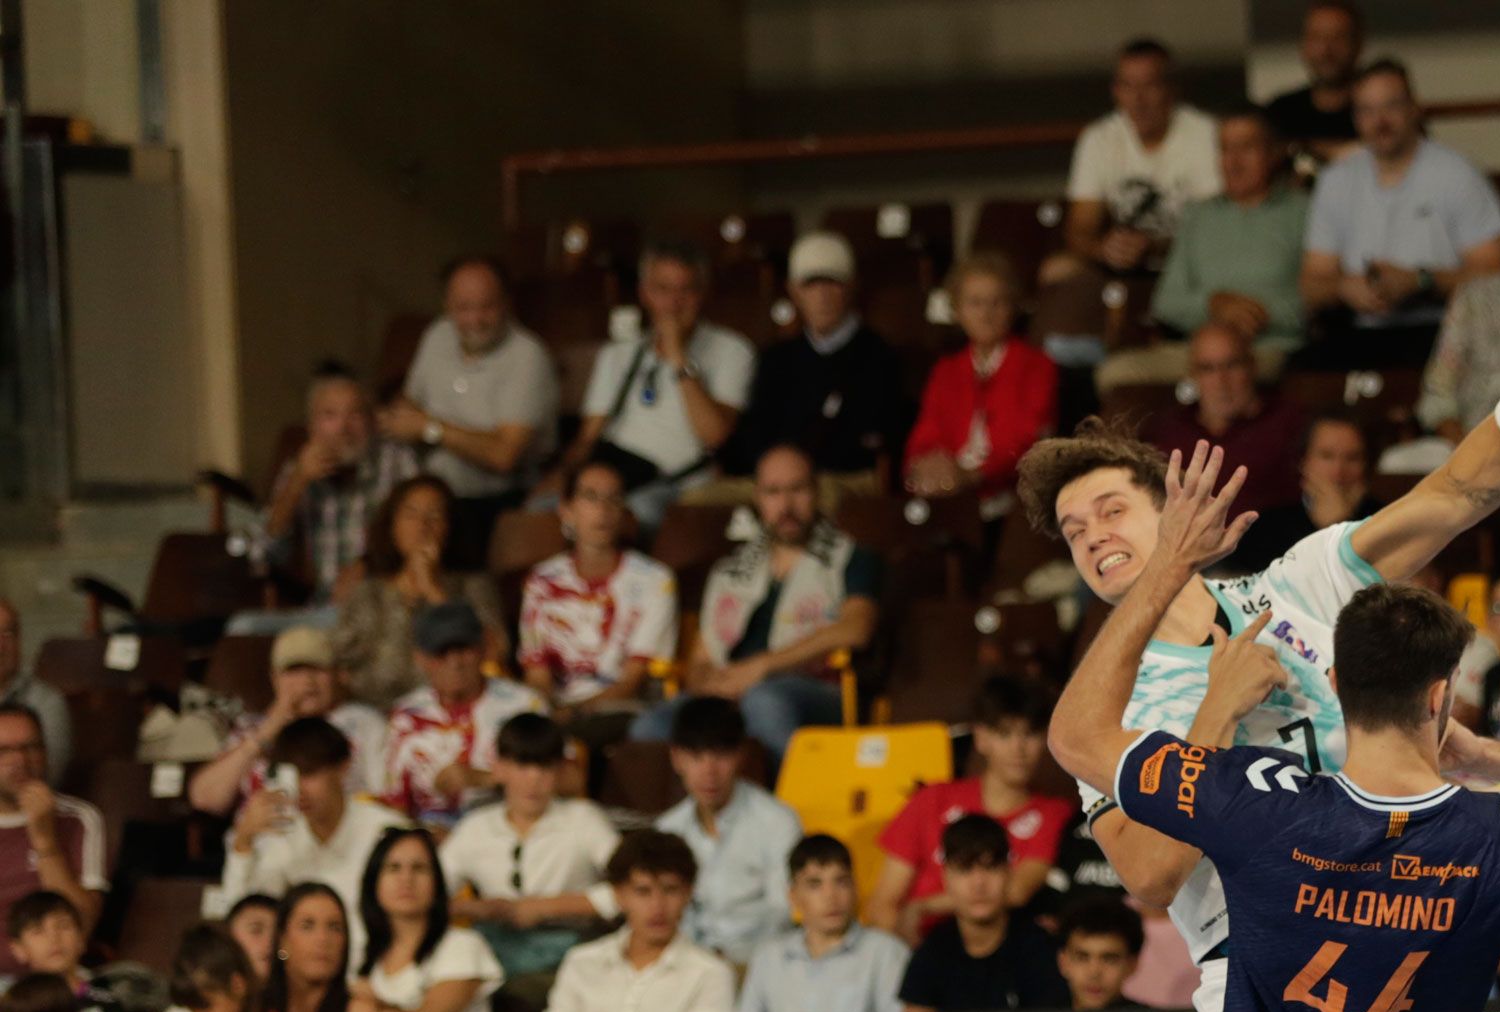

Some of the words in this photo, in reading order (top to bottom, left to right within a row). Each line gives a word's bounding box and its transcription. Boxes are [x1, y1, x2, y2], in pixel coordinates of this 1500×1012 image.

[1277, 717, 1321, 774] 7
[1177, 744, 1217, 819] gbar
[1291, 847, 1382, 873] bmgstore.cat
[1294, 883, 1456, 932] PALOMINO
